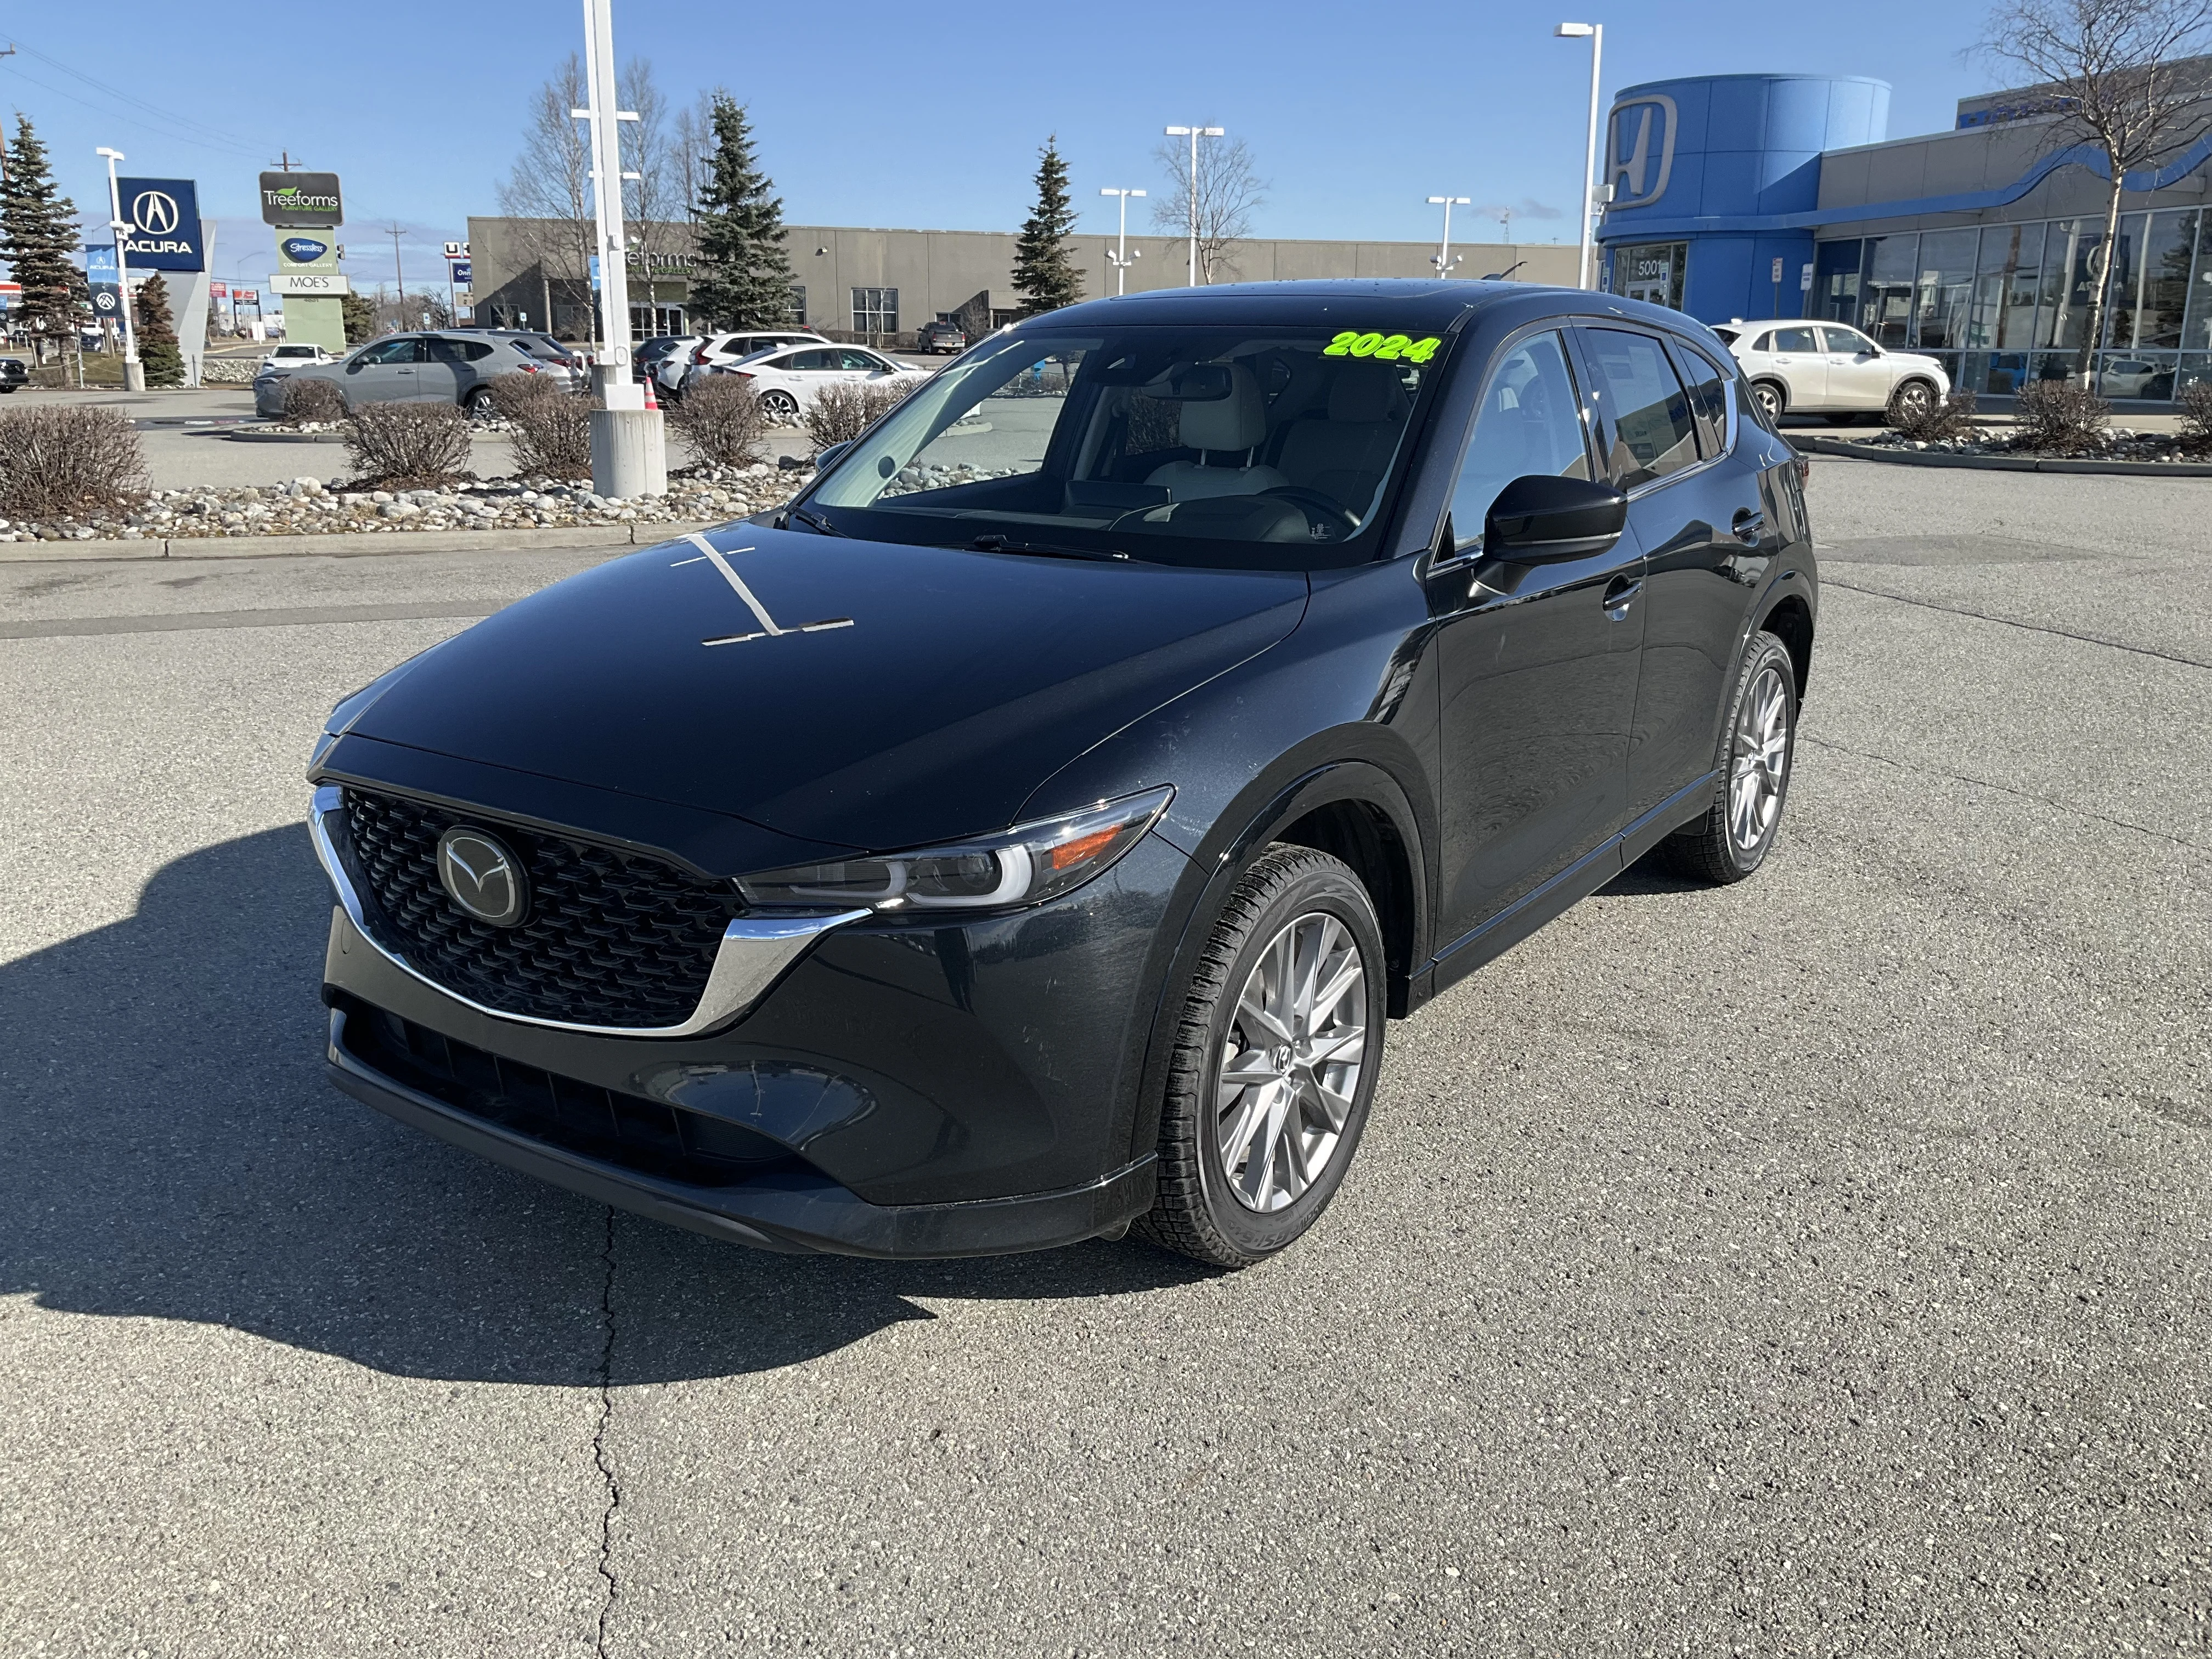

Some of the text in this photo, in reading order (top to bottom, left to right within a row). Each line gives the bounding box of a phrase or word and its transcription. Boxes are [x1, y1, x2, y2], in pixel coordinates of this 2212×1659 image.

[263, 190, 338, 206] Treeforms
[125, 240, 192, 253] ACURA
[290, 243, 323, 252] Stressless
[290, 277, 329, 288] MOE'S
[1323, 331, 1442, 363] 2024
